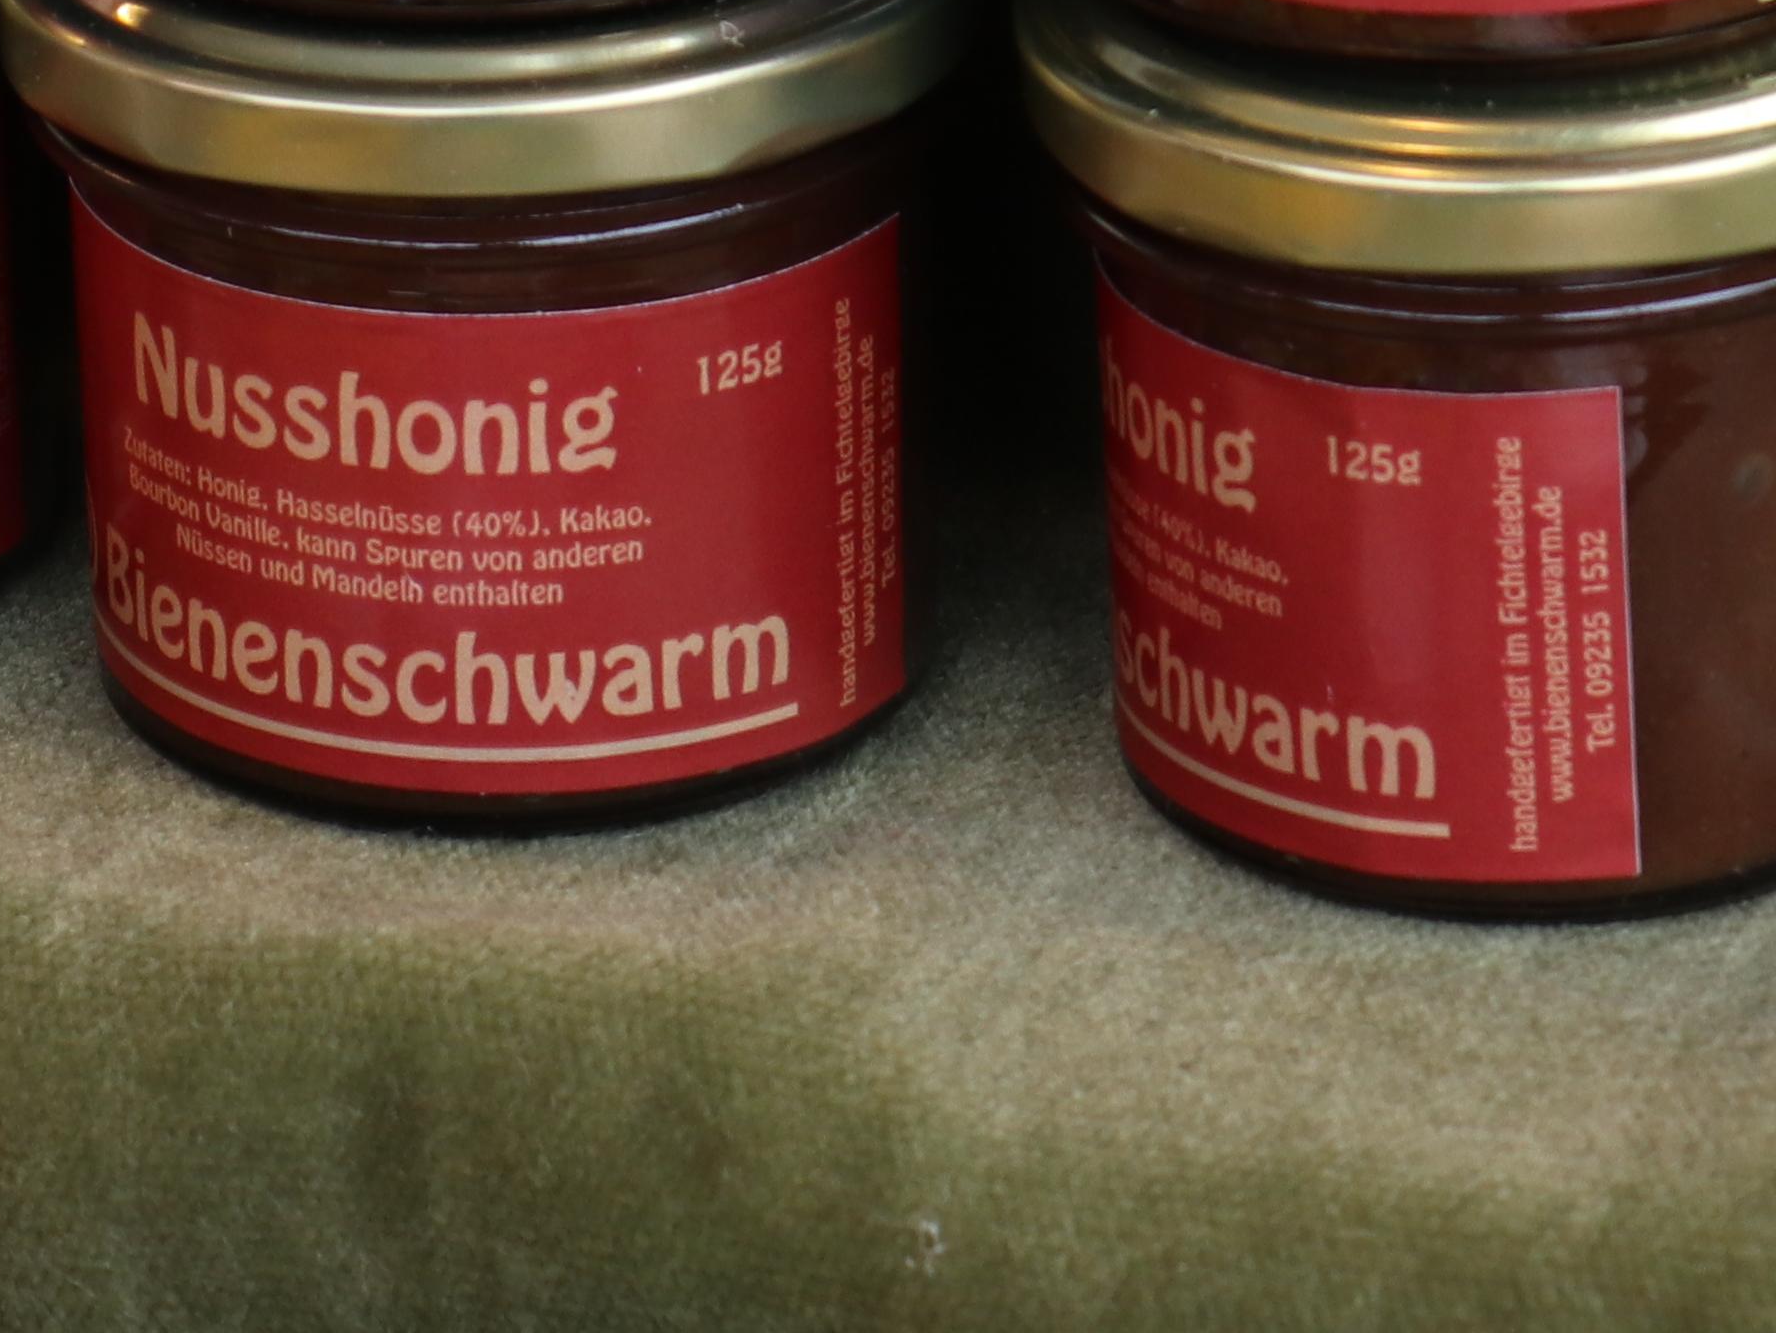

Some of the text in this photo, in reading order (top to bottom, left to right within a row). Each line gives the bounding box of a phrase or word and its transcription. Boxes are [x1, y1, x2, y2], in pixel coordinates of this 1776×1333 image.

[133, 311, 620, 477] Nusshonig
[696, 340, 784, 395] 125g
[1104, 337, 1422, 514] honig 125g
[105, 522, 791, 726] Bienenschwarm
[1118, 607, 1437, 799] schwarm
